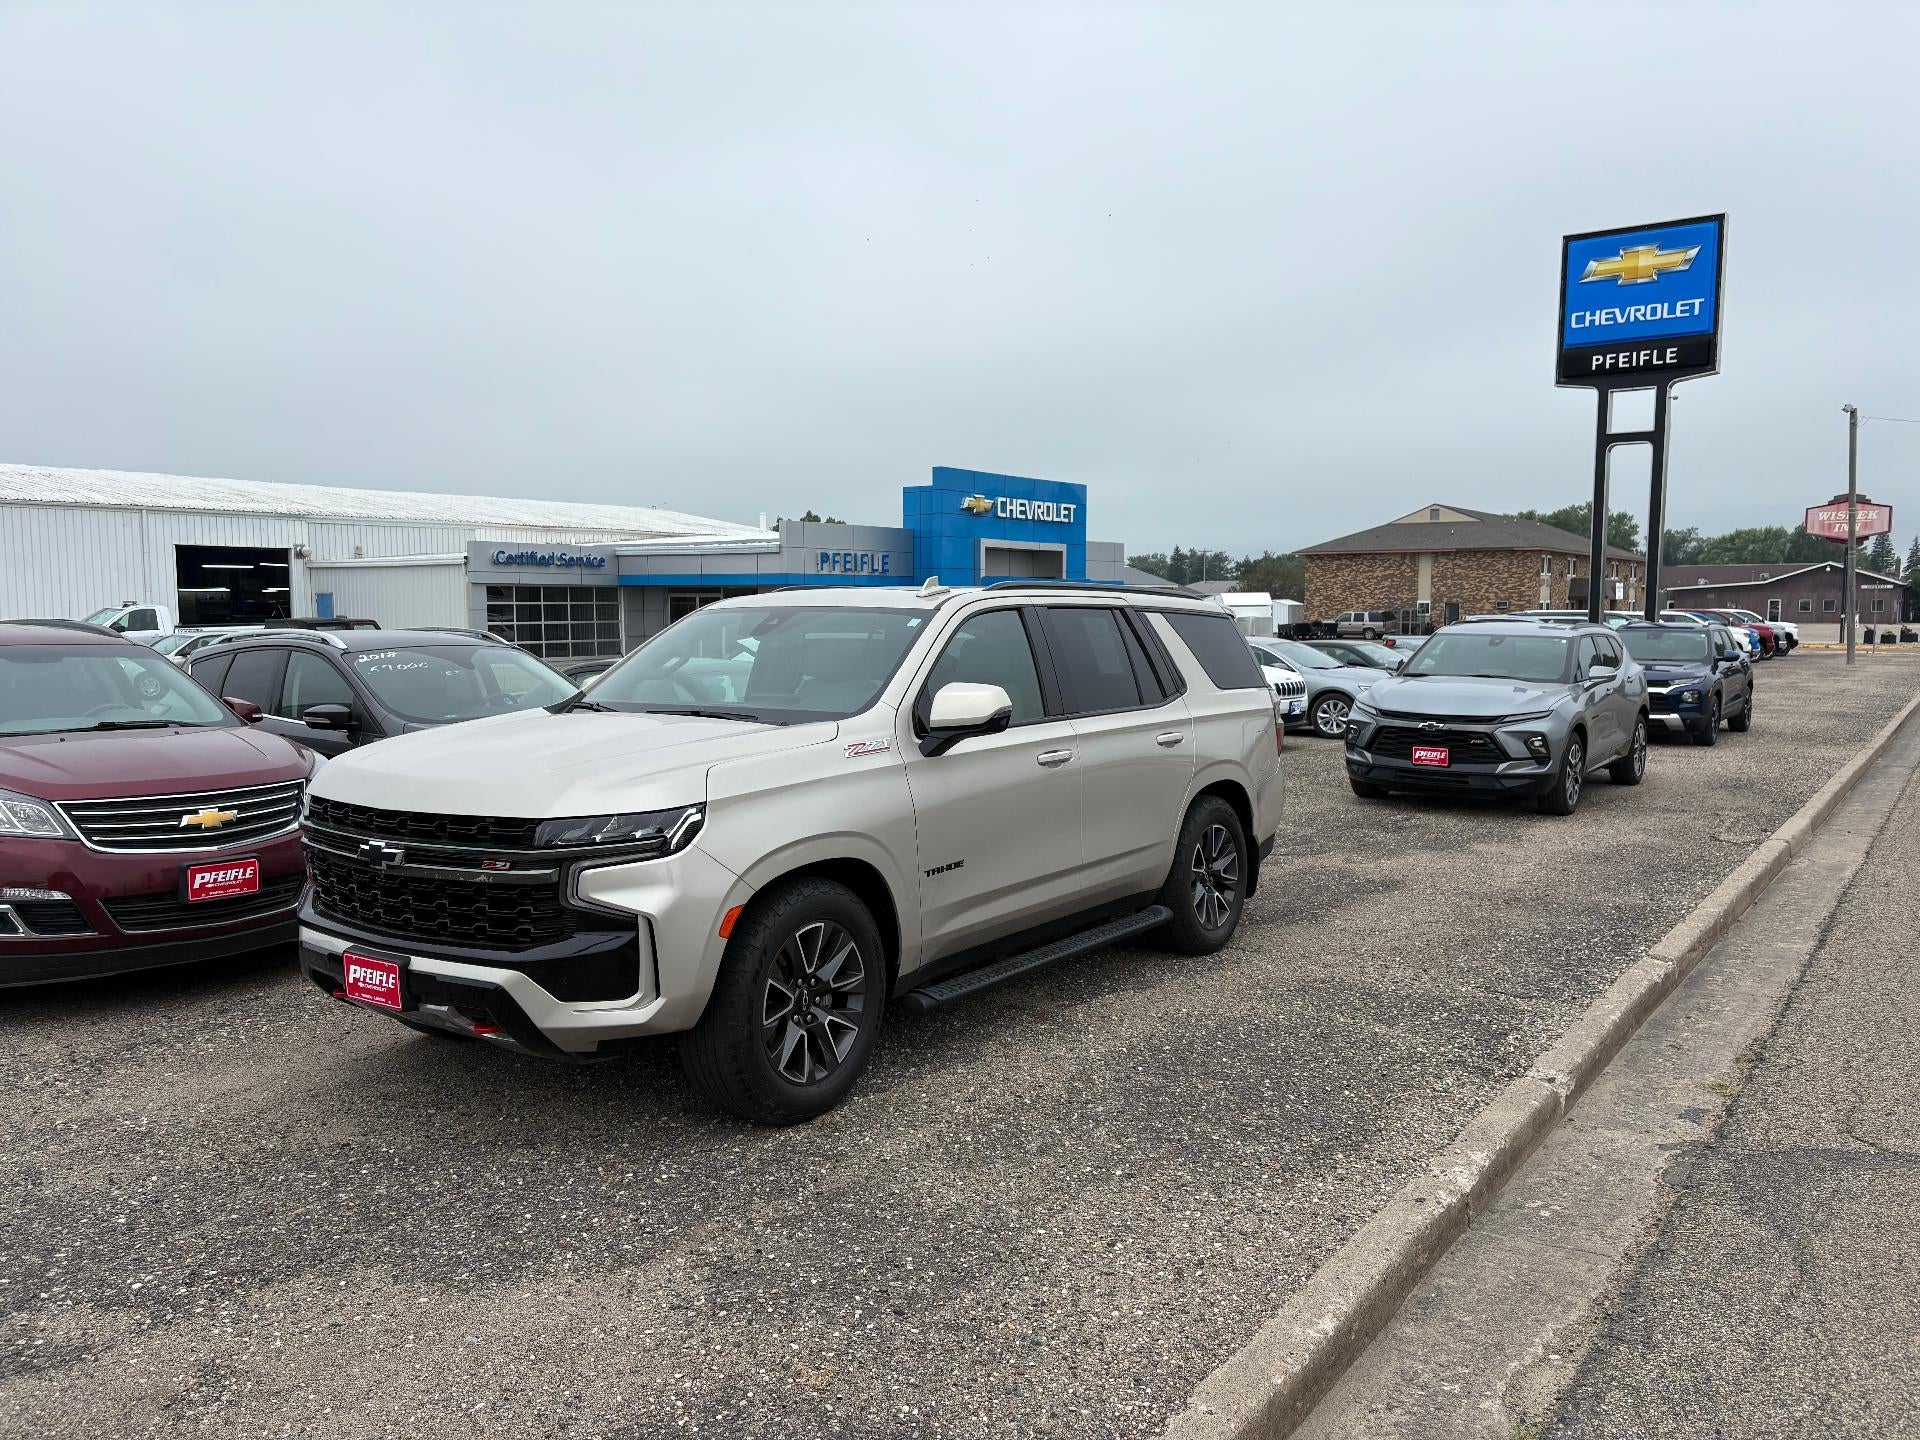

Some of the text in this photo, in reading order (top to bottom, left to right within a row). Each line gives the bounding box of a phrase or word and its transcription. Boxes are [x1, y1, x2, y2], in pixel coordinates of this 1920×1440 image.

[1570, 298, 1705, 329] CHEVROLET
[1591, 347, 1678, 371] PFEIFLE
[997, 496, 1077, 523] CHEVROLET
[1818, 510, 1879, 521] WISEK
[494, 550, 606, 568] Certified Service
[817, 551, 890, 575] PFEIFLE
[358, 651, 397, 662] 2018
[844, 737, 891, 759] Z71
[193, 866, 255, 889] PFEIFLE
[923, 859, 965, 879] TAHOE
[348, 964, 396, 989] PFEIFLE
